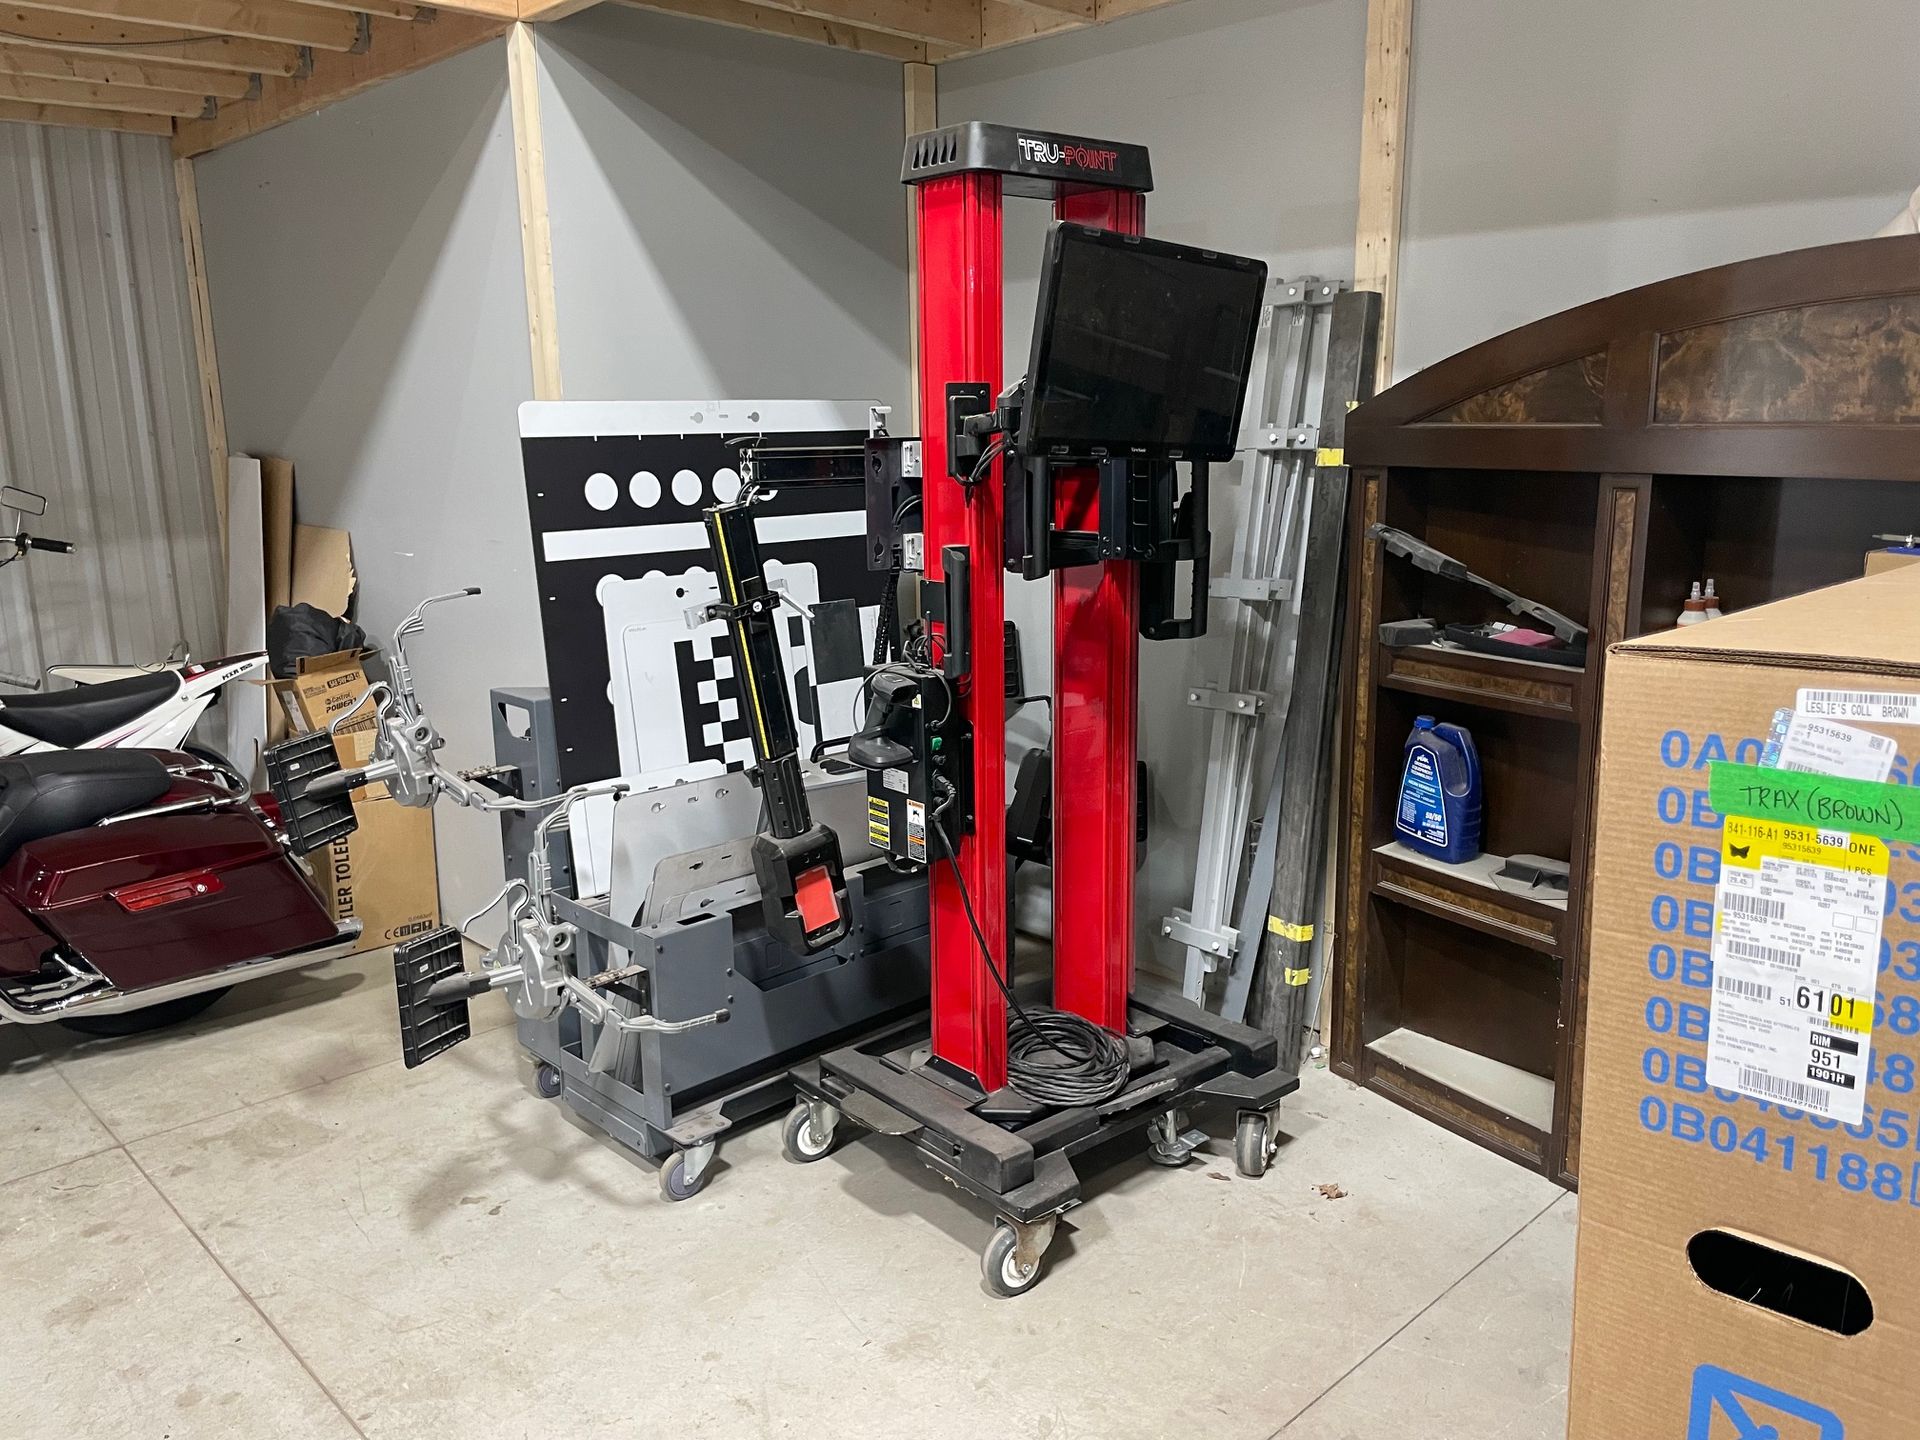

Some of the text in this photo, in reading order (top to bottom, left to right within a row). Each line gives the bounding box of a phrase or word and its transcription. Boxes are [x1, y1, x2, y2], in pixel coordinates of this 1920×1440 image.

[1018, 138, 1118, 171] TRU-POINT
[331, 693, 353, 704] Castrol
[1806, 702, 1909, 718] LESLIE'S COLL BROWN
[1808, 723, 1852, 742] 95315639
[1425, 811, 1442, 822] 50/50
[1739, 785, 1903, 831] TRAX (BROWN)
[1782, 842, 1822, 856] 95315639
[1784, 829, 1843, 848] 9531-5639
[1849, 841, 1876, 857] ONE
[1855, 866, 1872, 876] PCS
[1733, 911, 1768, 924] 95315639
[1839, 932, 1853, 941] PCS
[1779, 996, 1791, 1008] 51
[1797, 985, 1824, 1013] 61
[1830, 993, 1856, 1019] 01
[1812, 1033, 1831, 1048] RIM
[1810, 1048, 1841, 1069] 951
[1809, 1067, 1845, 1085] 1901H
[1639, 1095, 1902, 1202] 0B041188
